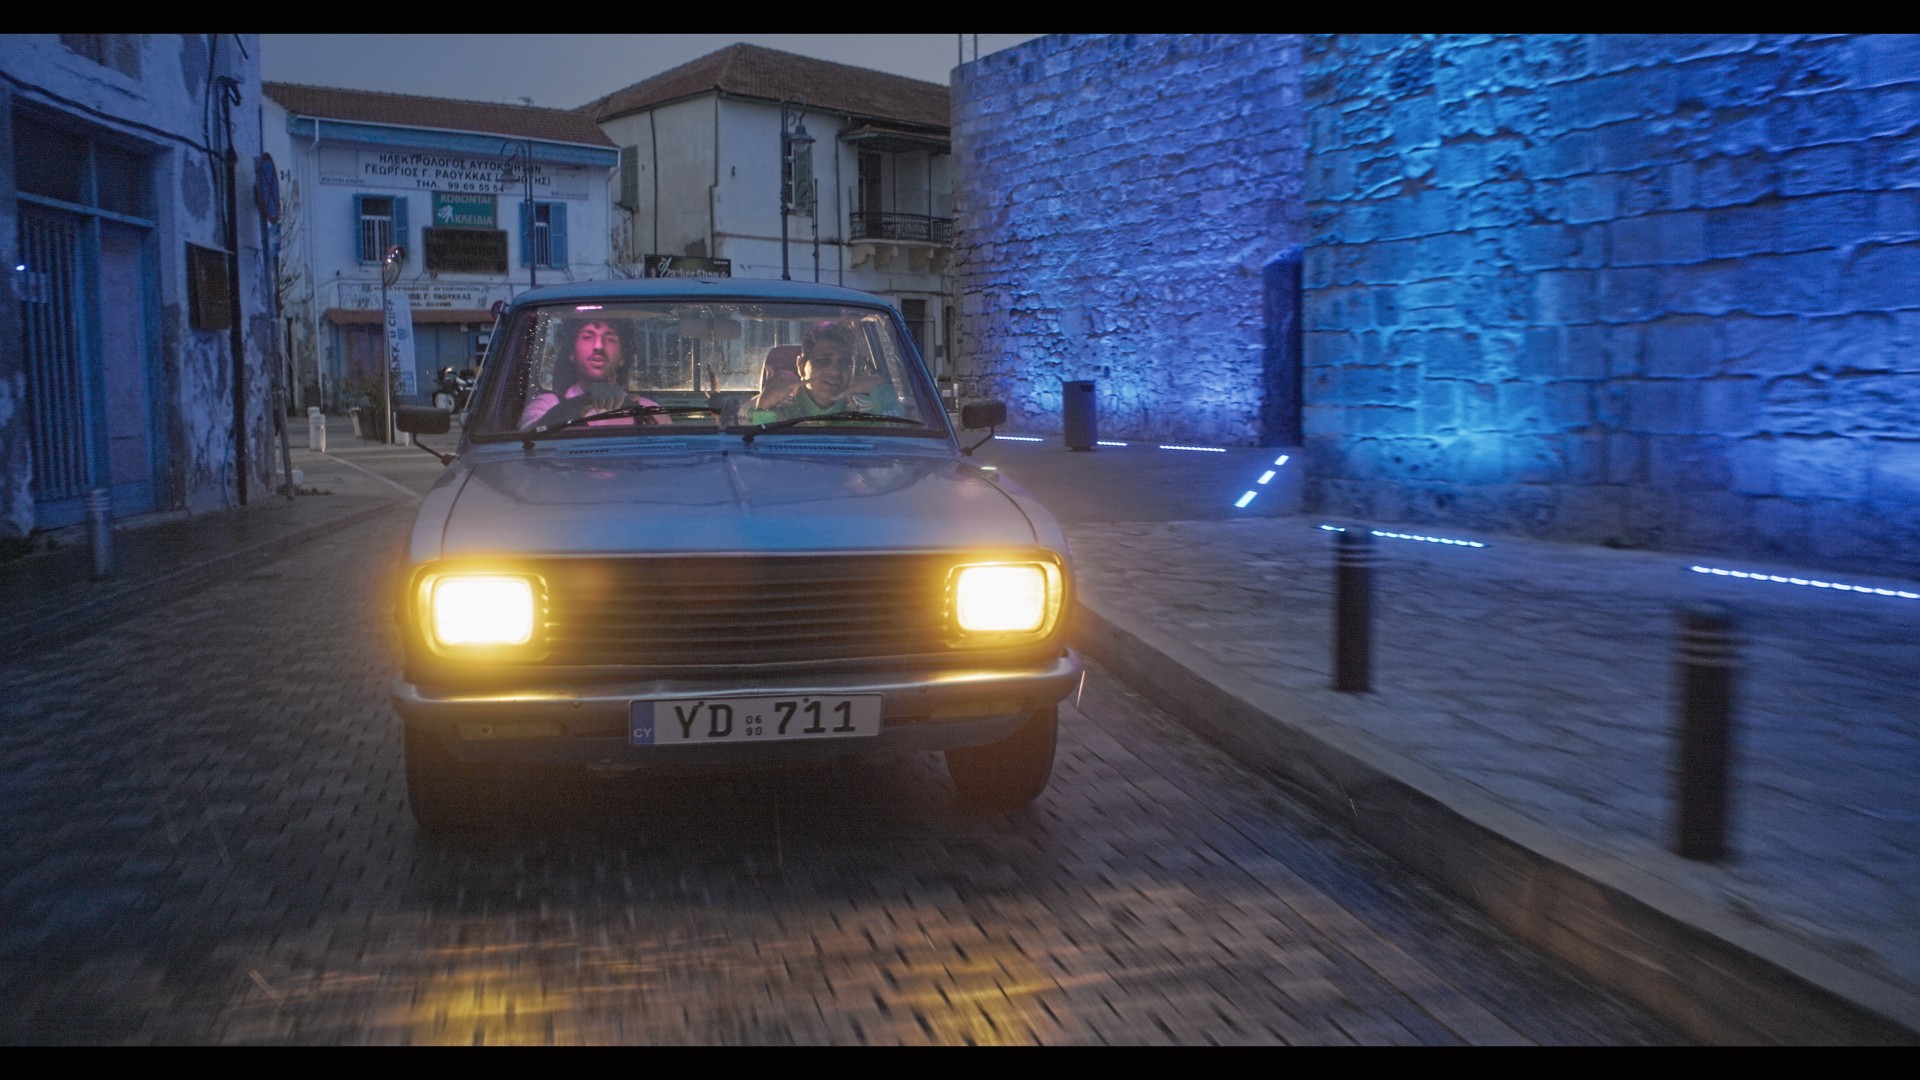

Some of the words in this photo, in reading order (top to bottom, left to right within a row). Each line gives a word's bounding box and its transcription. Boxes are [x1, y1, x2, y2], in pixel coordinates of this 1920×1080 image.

[379, 154, 466, 169] ΗΛΕΚΤΡΟΛΟΓΟΣ
[365, 164, 418, 178] ΓΕΩΡΓΙΟΣ
[435, 169, 492, 183] ΡΑΟΥΚΚΑΣ
[416, 180, 440, 189] ΤΗΛ.
[448, 182, 459, 190] 99
[440, 193, 491, 204] ΚΟΒΟΝΤΑΙ
[454, 215, 494, 225] ΚΛΕΙΔΙΑ
[433, 293, 472, 301] ΡΑΟΥΚΚΑΣ
[674, 704, 733, 739] YD
[774, 700, 856, 735] 711
[746, 715, 762, 724] 06
[633, 728, 652, 738] CY
[745, 727, 762, 736] 90
